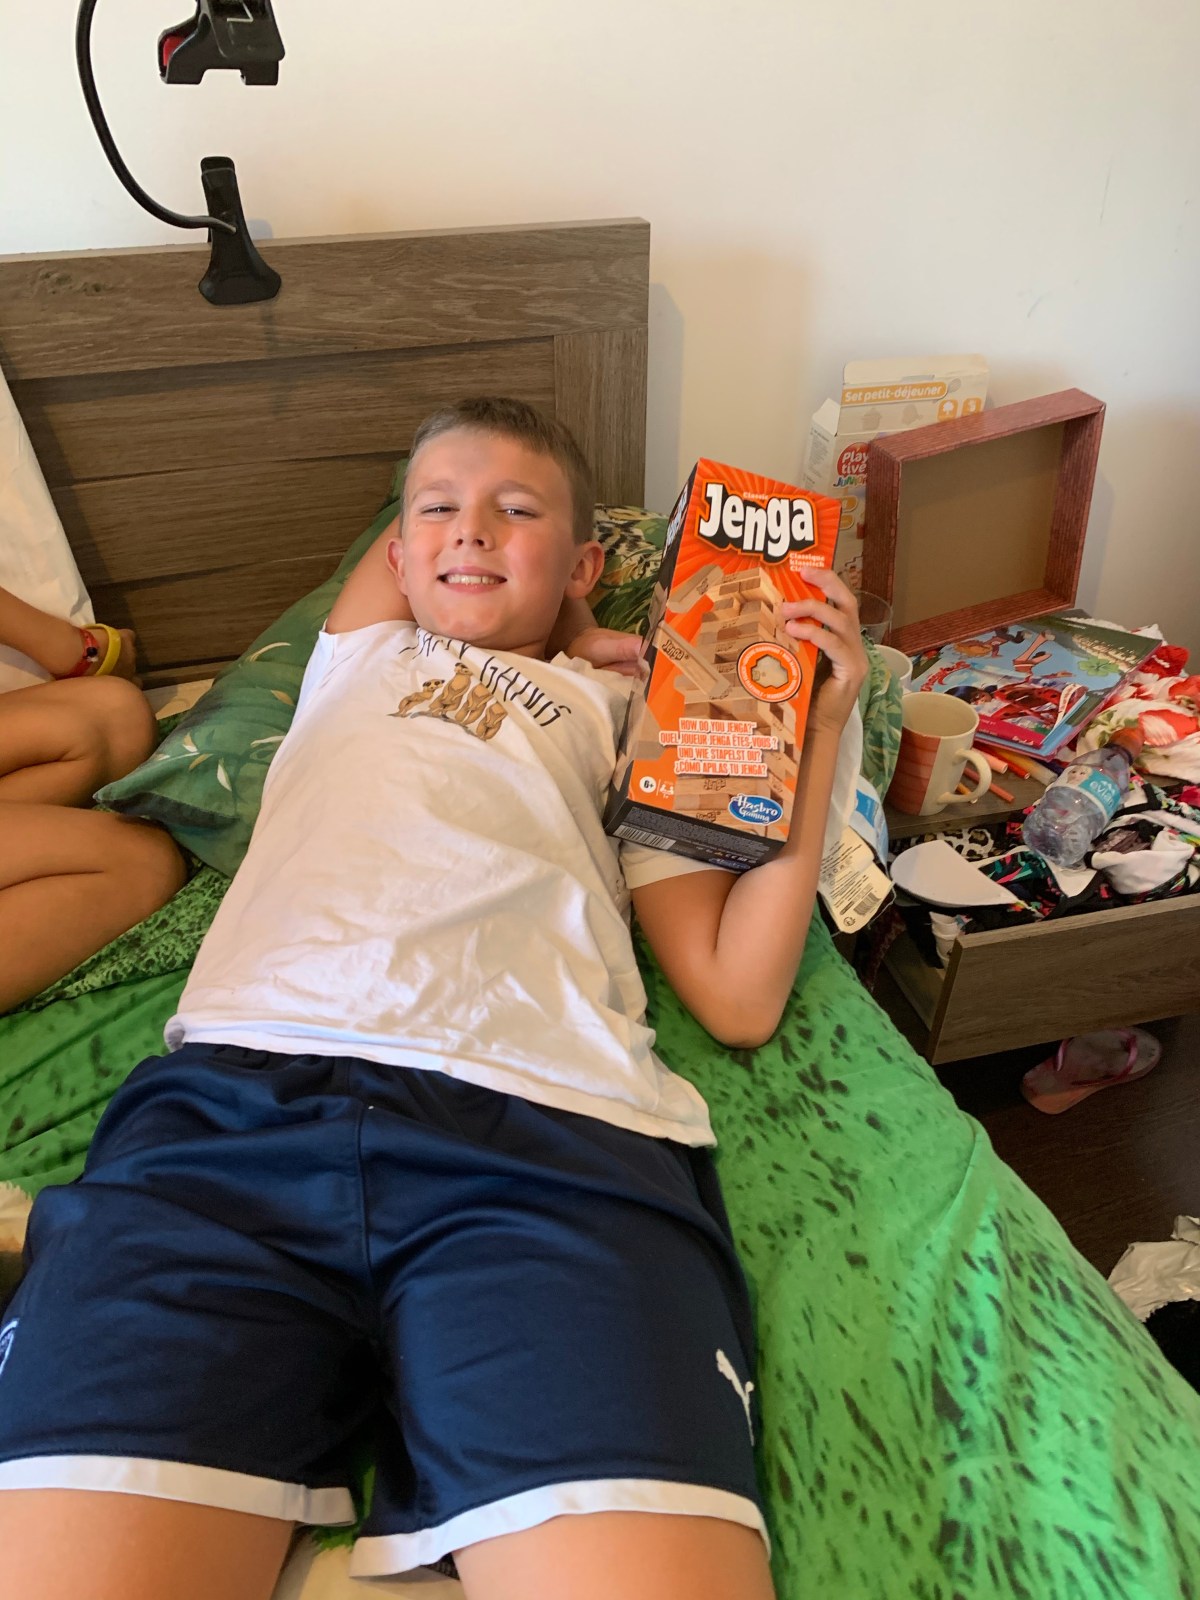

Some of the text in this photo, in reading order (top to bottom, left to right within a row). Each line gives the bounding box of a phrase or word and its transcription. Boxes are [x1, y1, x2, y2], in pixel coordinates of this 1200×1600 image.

[845, 386, 943, 402] Set petit-déjeuner
[842, 450, 869, 463] Play
[842, 461, 867, 474] tive
[698, 483, 815, 558] Jenga
[790, 552, 825, 561] Classique
[680, 719, 697, 731] HOW
[699, 720, 709, 732] DO
[710, 721, 725, 733] YOU
[661, 732, 678, 743] QUEL
[681, 733, 707, 745] JOUEUR
[710, 735, 730, 746] JENGA
[679, 747, 693, 758] UND
[695, 748, 709, 759] WIE
[711, 749, 745, 761] STAPELST
[703, 762, 728, 773] APILAS
[741, 764, 766, 775] JENGA?
[643, 780, 654, 788] 6+
[730, 794, 778, 816] Hasbro
